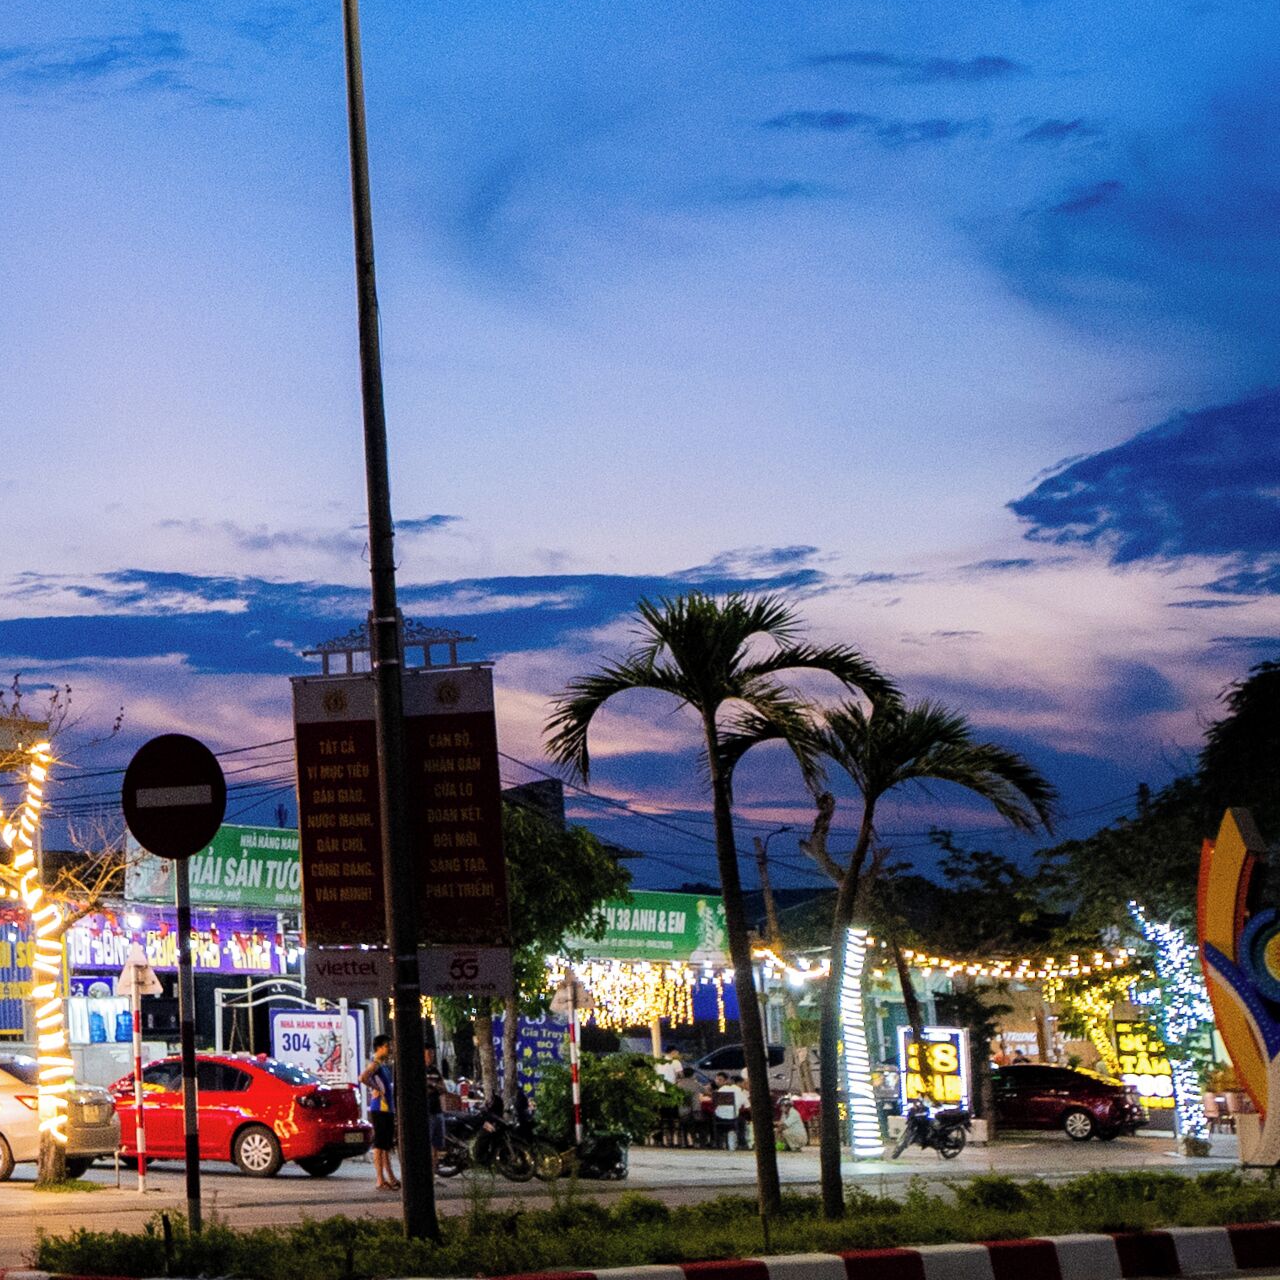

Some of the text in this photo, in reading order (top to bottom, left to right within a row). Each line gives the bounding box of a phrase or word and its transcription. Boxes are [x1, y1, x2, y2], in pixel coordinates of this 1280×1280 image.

[189, 846, 302, 890] HẢI SẢN TƯƠ
[617, 908, 630, 932] 38
[630, 908, 658, 933] ANH
[657, 910, 667, 933] &
[667, 911, 687, 934] EM
[315, 960, 378, 976] viettel
[449, 958, 479, 980] 5G
[282, 1033, 311, 1052] 304
